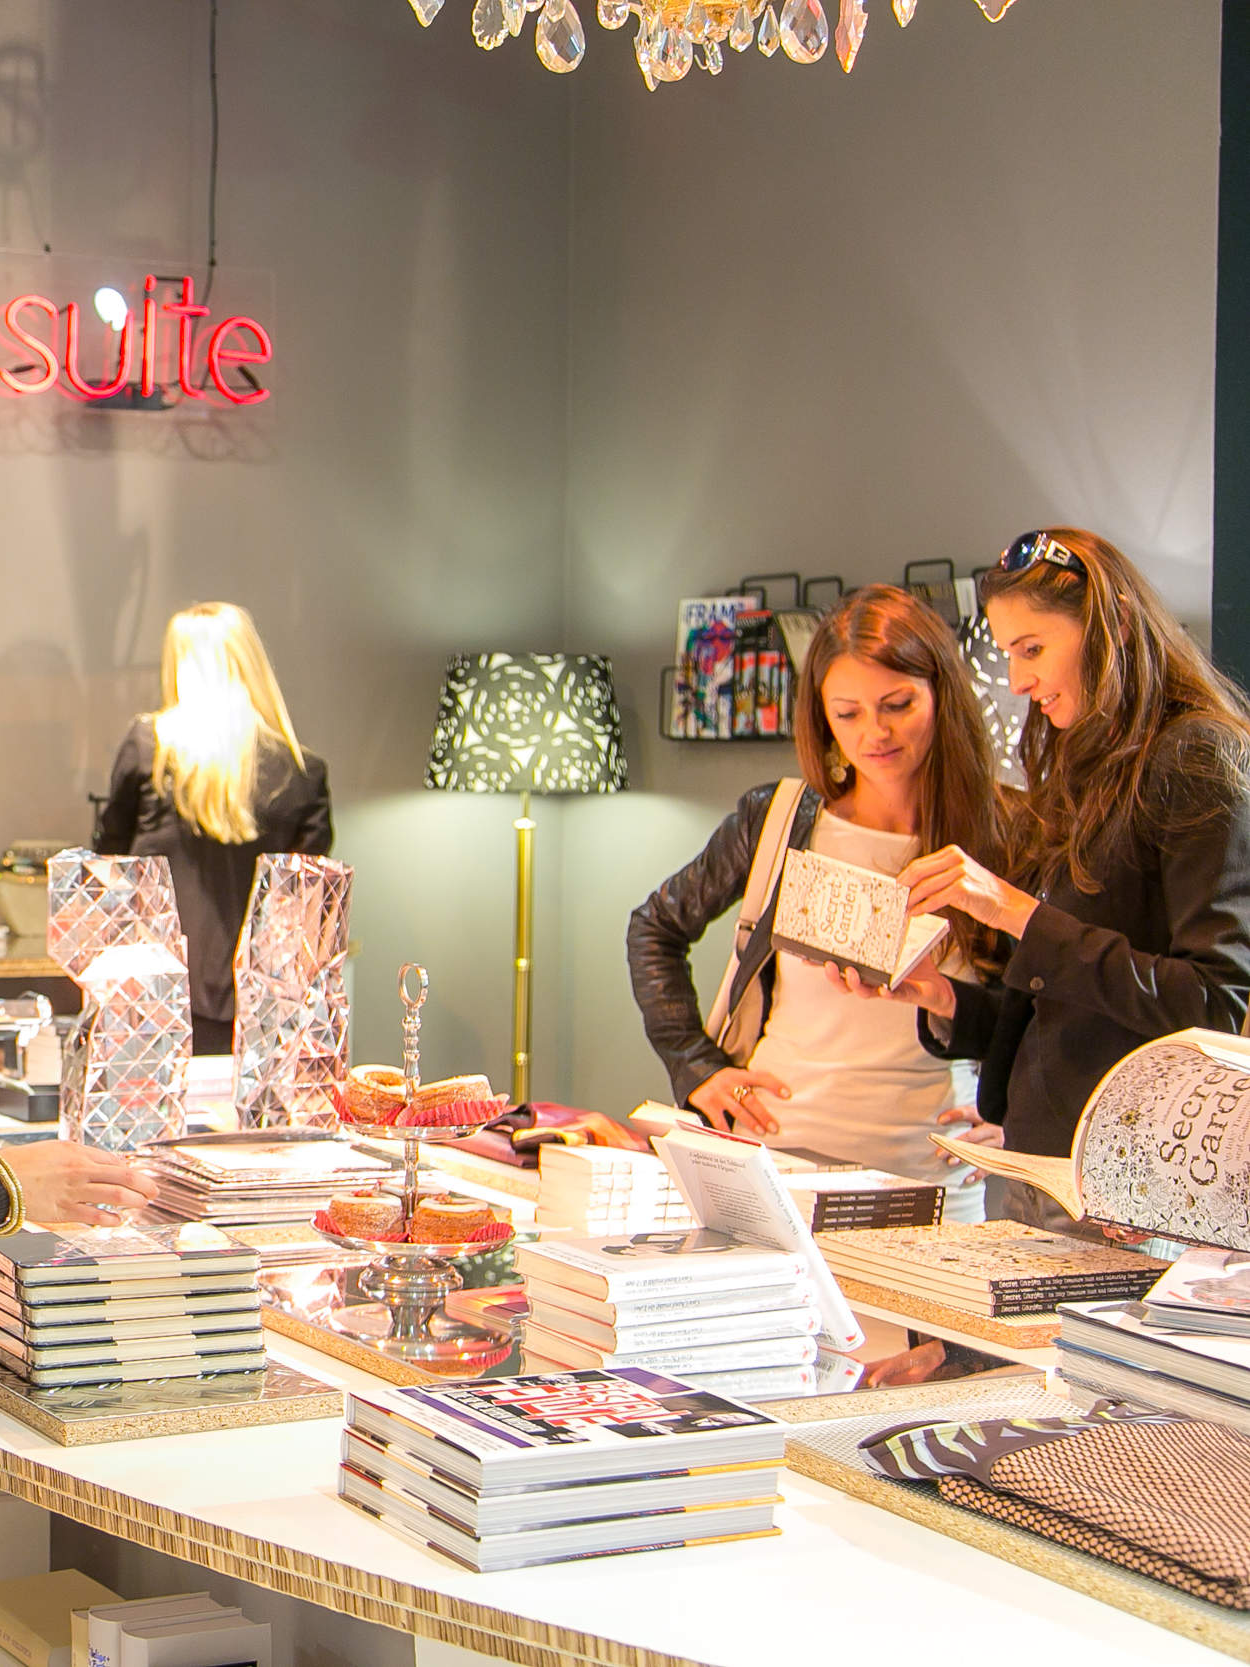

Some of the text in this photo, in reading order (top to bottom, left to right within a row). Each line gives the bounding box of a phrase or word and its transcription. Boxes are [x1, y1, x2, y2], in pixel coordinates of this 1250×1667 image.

[820, 880, 842, 936] Secret
[833, 882, 858, 945] Garden
[1189, 1078, 1250, 1186] Garde
